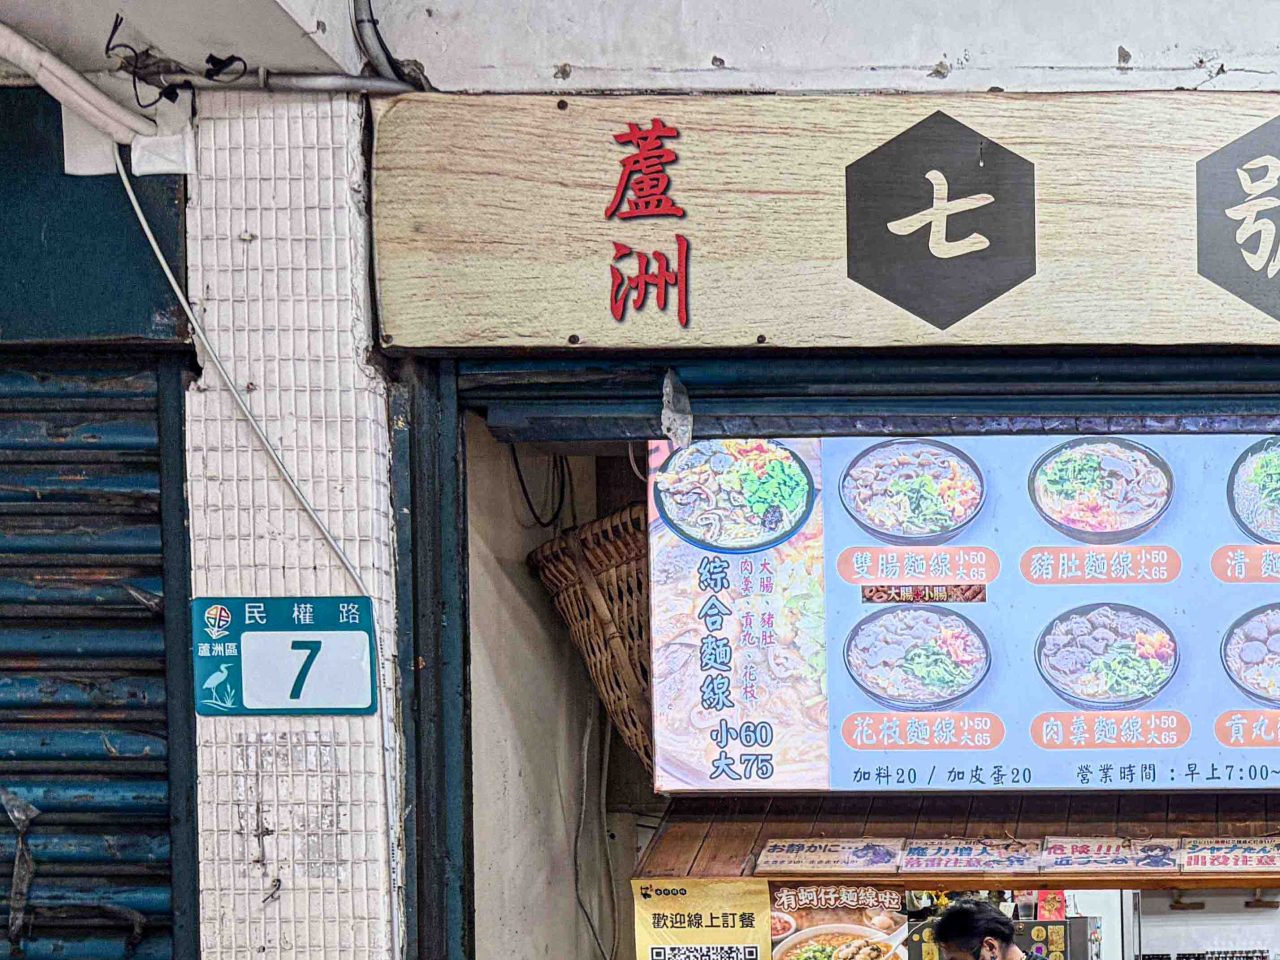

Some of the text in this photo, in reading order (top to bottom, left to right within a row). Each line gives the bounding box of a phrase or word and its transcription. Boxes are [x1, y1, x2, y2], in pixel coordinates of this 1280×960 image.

[604, 117, 691, 329] 蘆洲
[852, 550, 954, 580] 雙腸麵線
[1030, 550, 1136, 580] 豬肚麵線
[244, 602, 360, 626] 民權路
[697, 556, 733, 712] 綜合麵線
[197, 642, 238, 657] 蘆洲區
[289, 640, 323, 700] 7
[709, 718, 775, 748] 小60
[852, 716, 960, 748] 花枝麵線
[1041, 715, 1146, 746] 肉羹麵線
[709, 749, 775, 782] 大75
[853, 764, 918, 785] 加料20
[947, 763, 1032, 785] 加皮蛋20
[652, 911, 756, 929] 歡迎線上訂餐
